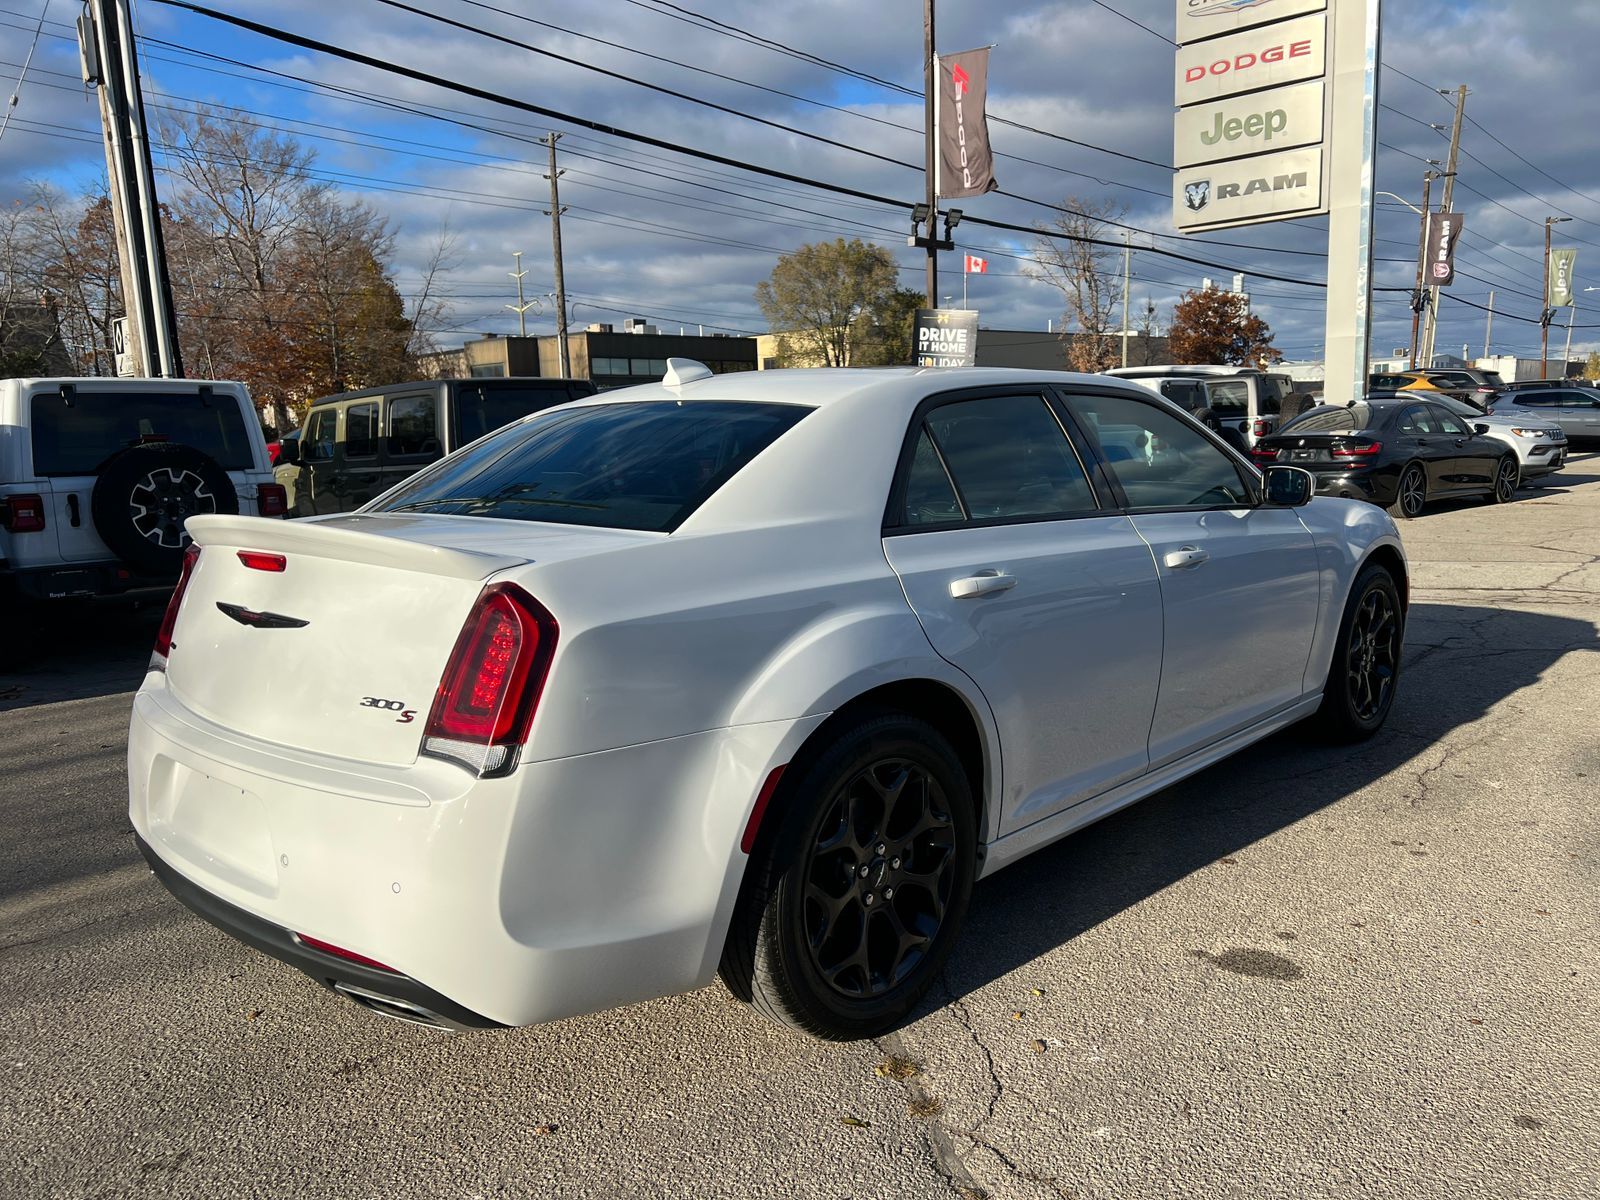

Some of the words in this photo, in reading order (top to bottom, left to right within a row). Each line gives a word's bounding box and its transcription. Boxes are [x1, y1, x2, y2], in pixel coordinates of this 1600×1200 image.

[1185, 40, 1311, 82] DODGE
[955, 81, 971, 188] DODGE
[1200, 108, 1287, 145] Jeep
[1217, 172, 1307, 200] RAM
[1438, 220, 1450, 261] RAM
[1554, 259, 1569, 296] Jeep
[918, 341, 929, 350] IT
[931, 342, 966, 352] HOME
[919, 328, 967, 342] DRIVE
[360, 697, 405, 711] 300
[396, 710, 417, 723] S
